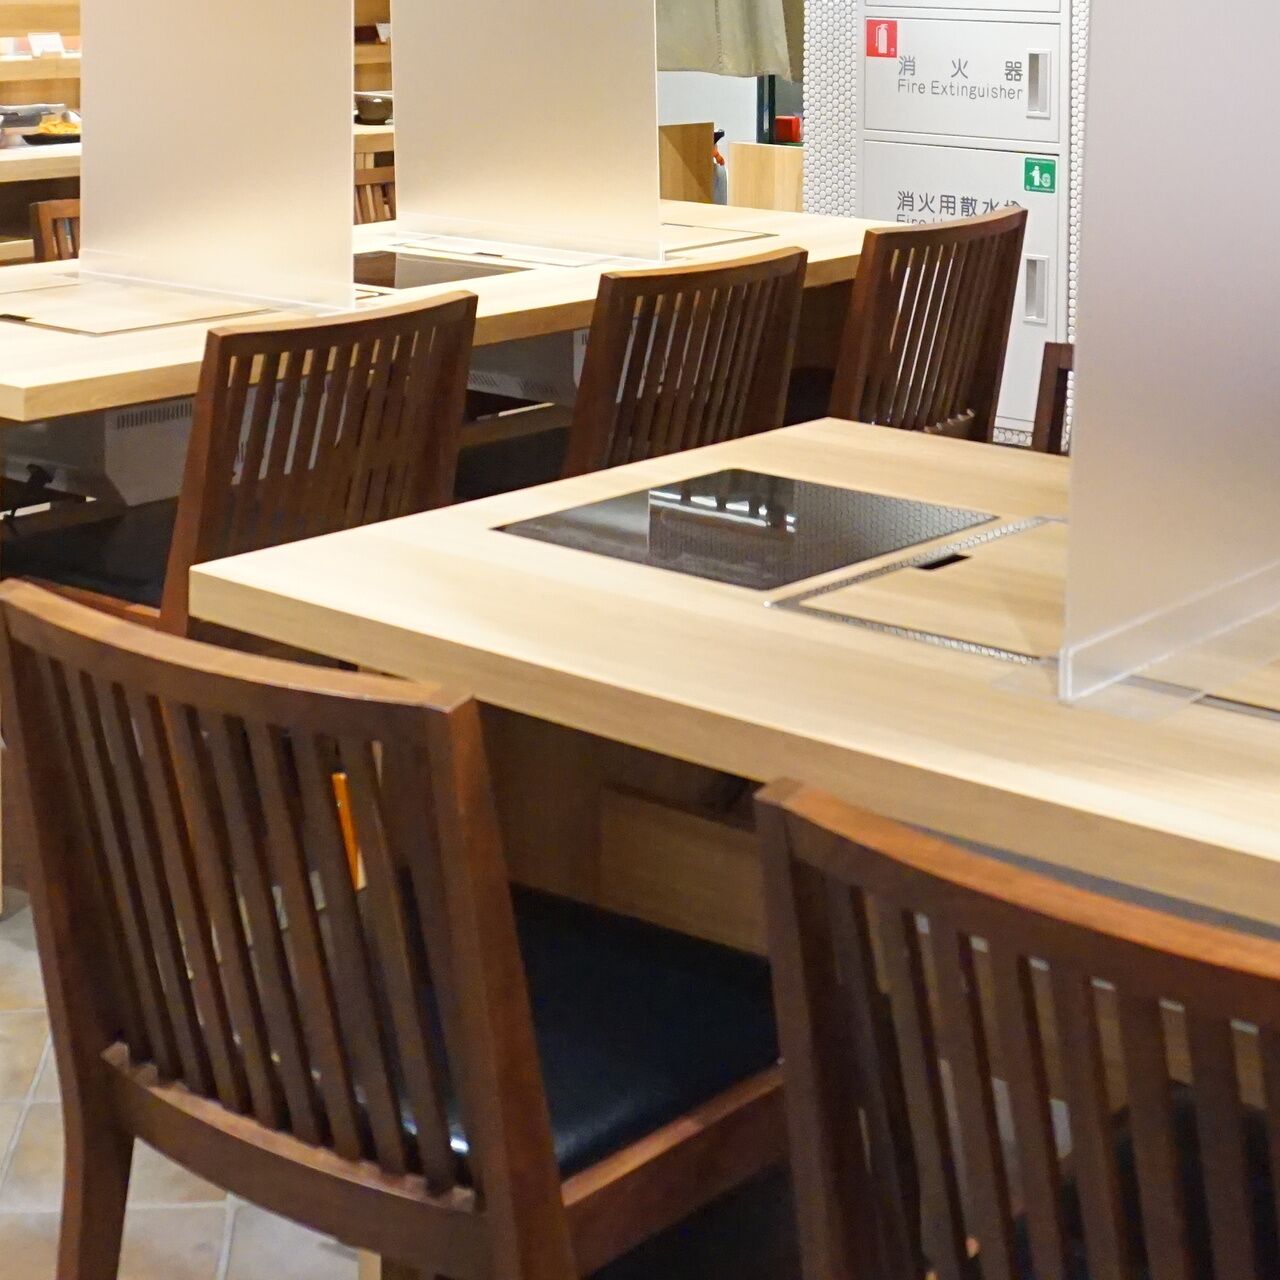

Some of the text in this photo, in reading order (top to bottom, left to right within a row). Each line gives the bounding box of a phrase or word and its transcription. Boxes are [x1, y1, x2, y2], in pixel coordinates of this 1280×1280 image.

[898, 55, 1024, 82] 消火器
[897, 78, 1024, 100] Fire Extinguisher
